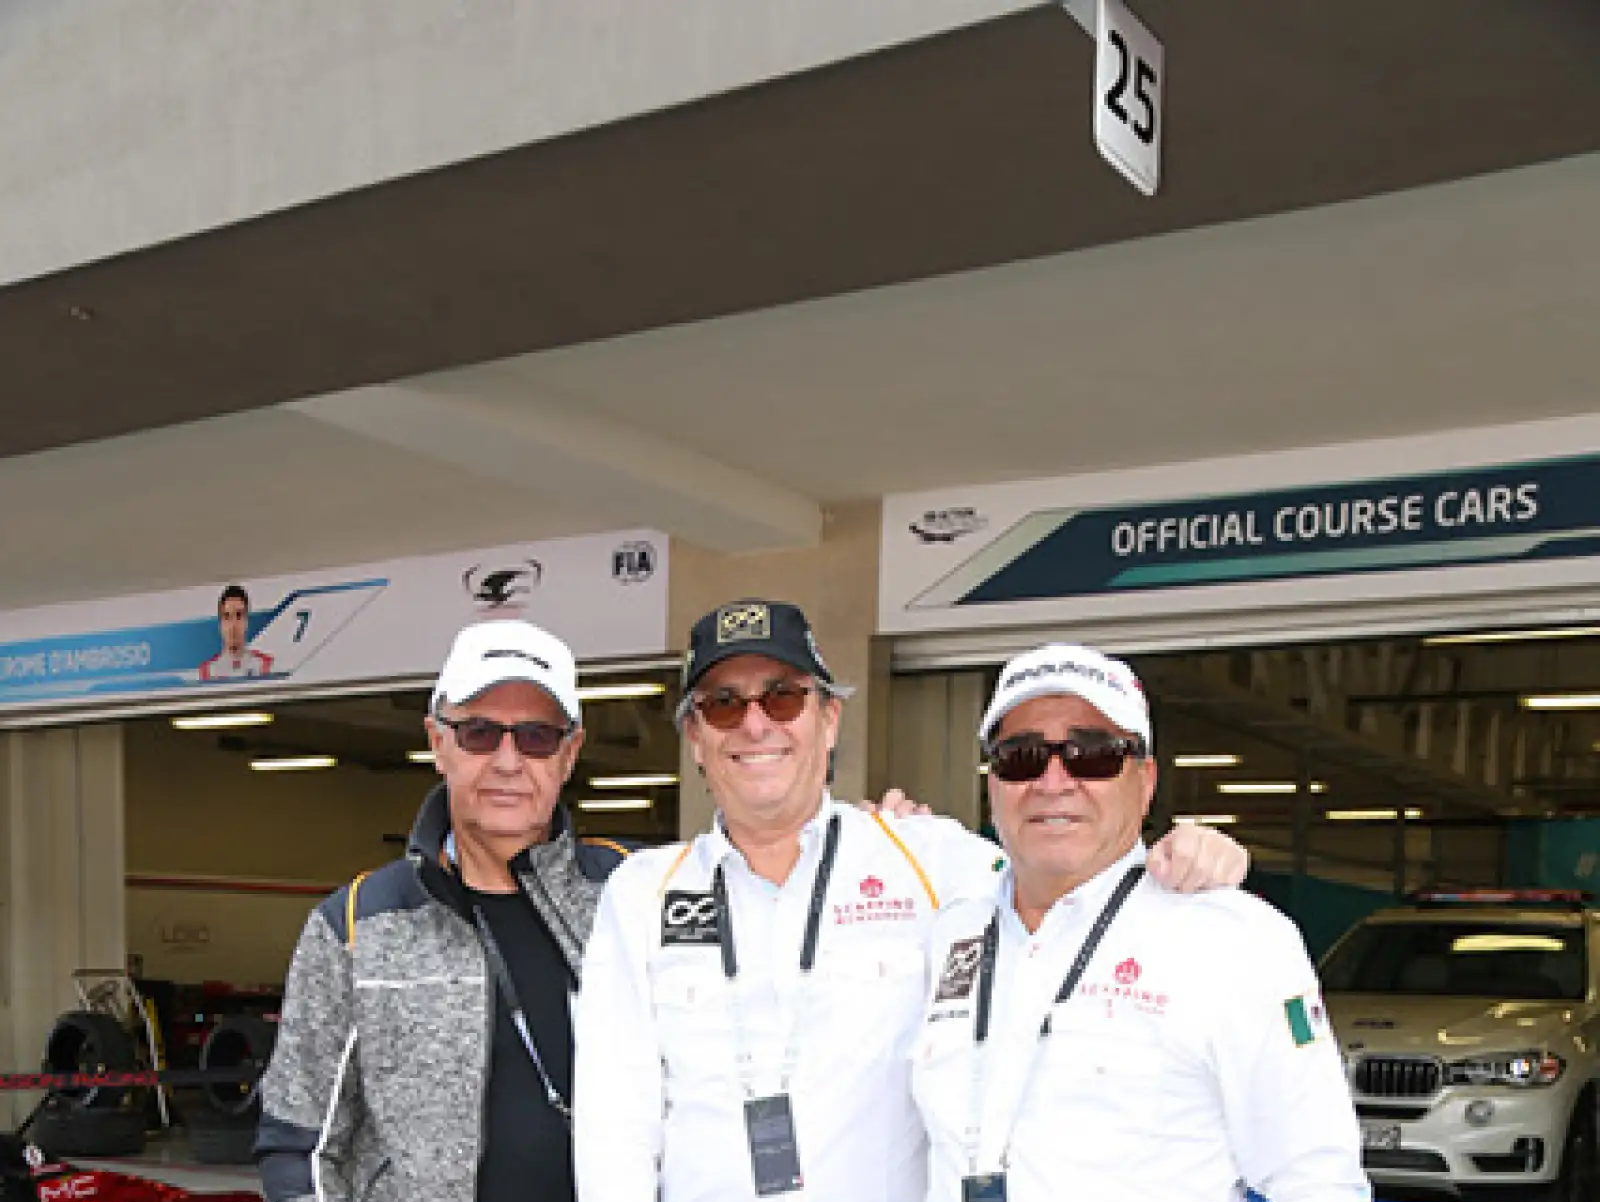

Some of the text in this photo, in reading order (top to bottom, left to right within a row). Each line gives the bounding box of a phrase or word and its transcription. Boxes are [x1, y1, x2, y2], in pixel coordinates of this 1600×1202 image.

[1104, 29, 1157, 145] 25
[1112, 484, 1541, 556] OFFICIAL COURSE CARS
[612, 550, 654, 576] FIA
[293, 610, 312, 643] 7
